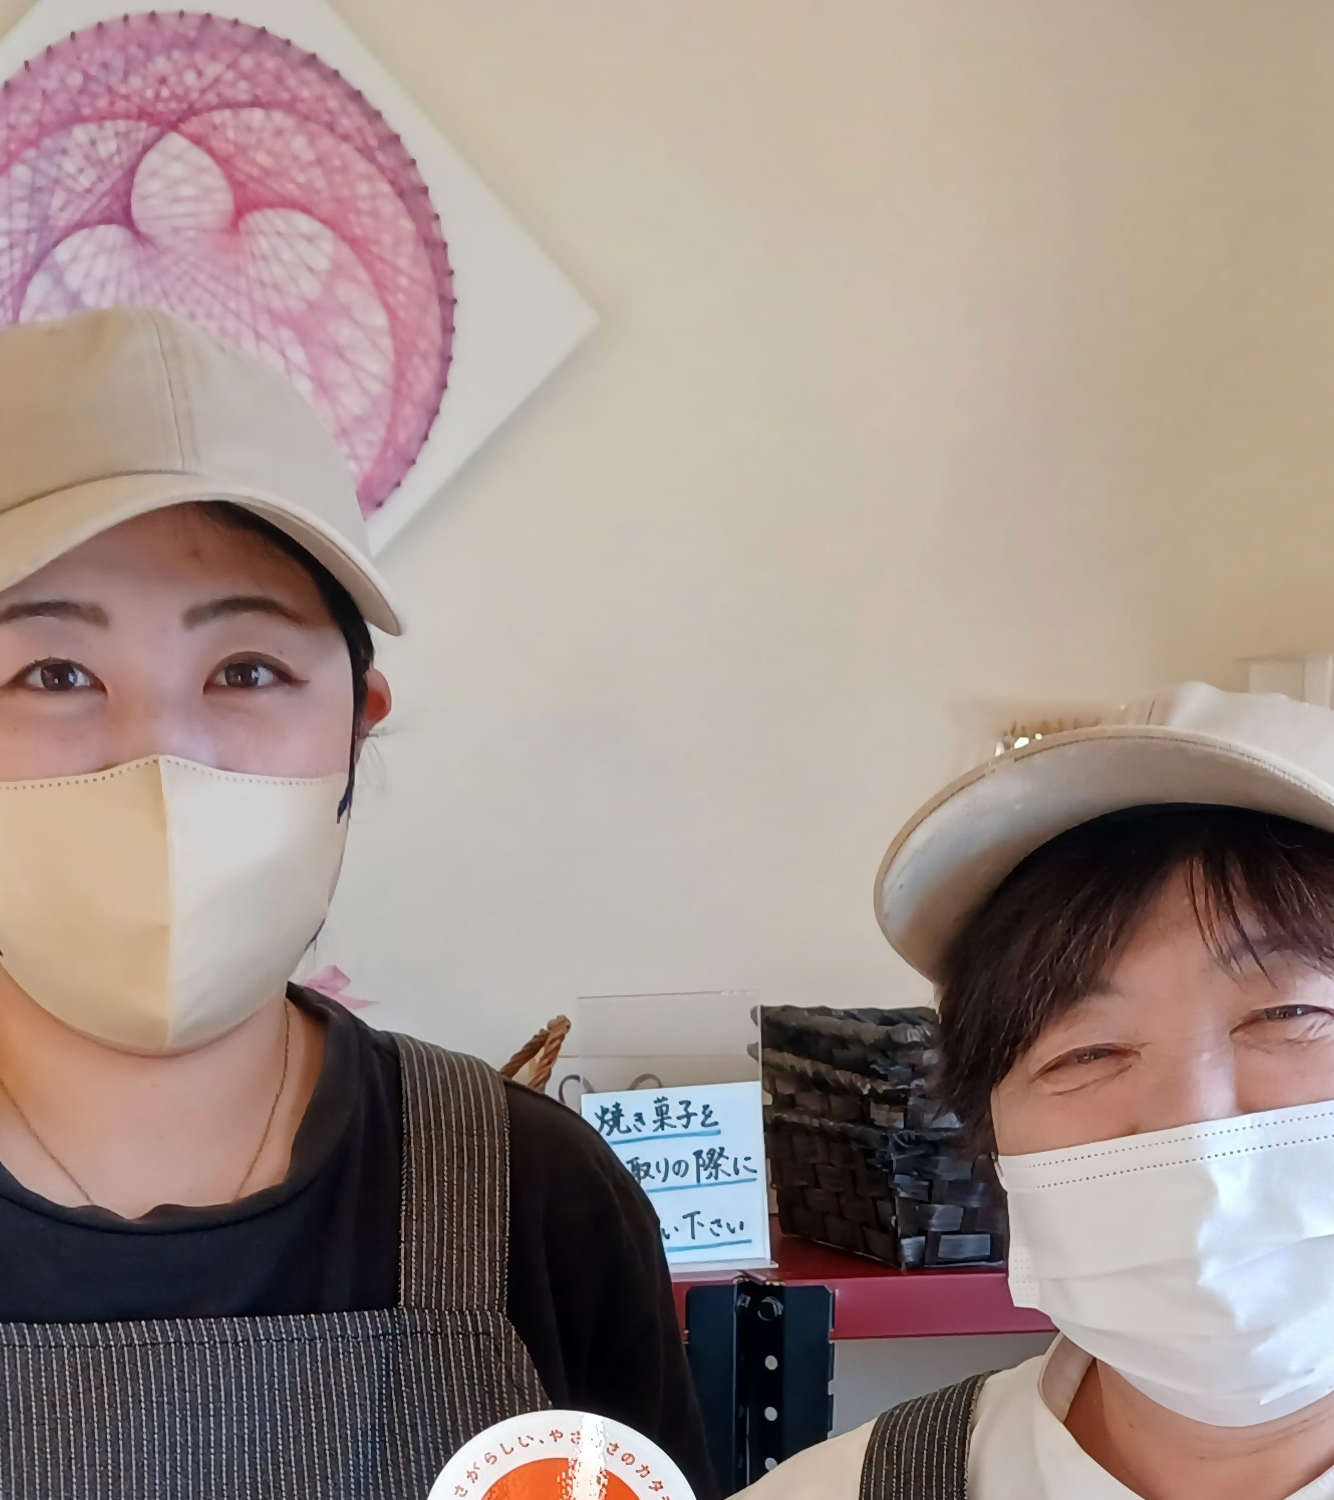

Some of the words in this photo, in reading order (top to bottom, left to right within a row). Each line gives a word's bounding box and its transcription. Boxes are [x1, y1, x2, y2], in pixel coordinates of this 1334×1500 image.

[594, 1096, 719, 1136] 焼き菓子を
